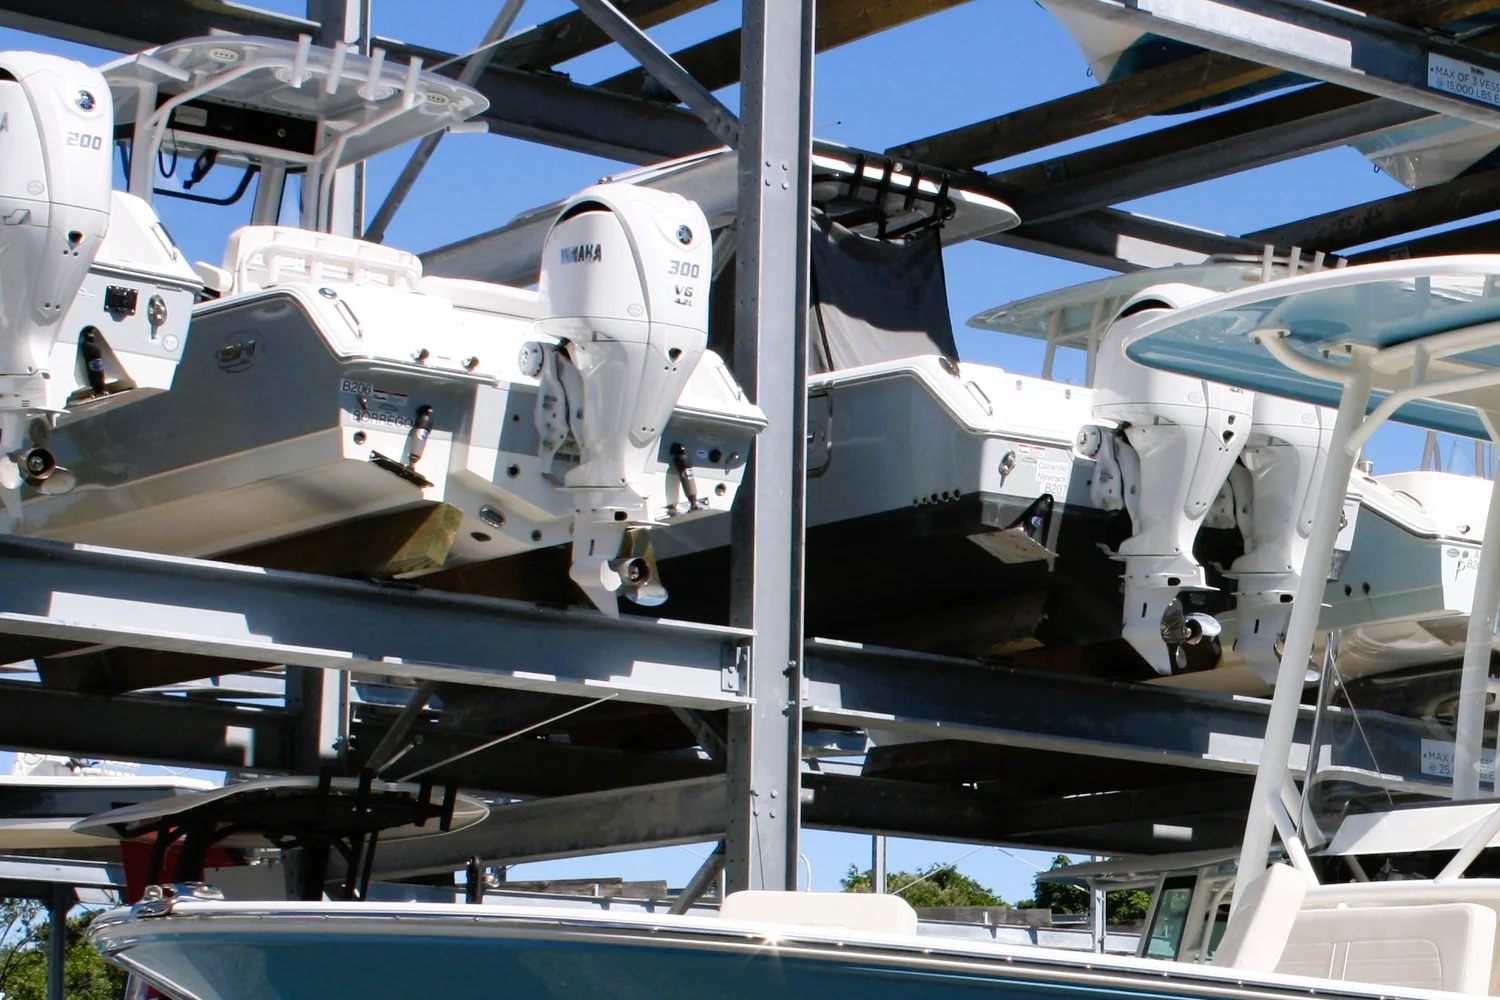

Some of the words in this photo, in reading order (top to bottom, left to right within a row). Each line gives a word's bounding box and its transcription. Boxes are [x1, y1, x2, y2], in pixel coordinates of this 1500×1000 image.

[1435, 66, 1455, 78] MAX
[1457, 72, 1470, 83] OF
[1472, 76, 1477, 86] 3
[1446, 80, 1474, 95] 15,000
[1476, 88, 1492, 101] LBS
[66, 131, 103, 151] 200
[668, 260, 700, 279] 300
[674, 284, 694, 298] V6
[342, 380, 372, 395] B206
[353, 409, 413, 428] BORREGO
[1045, 483, 1068, 495] B207
[1428, 751, 1448, 762] MAX
